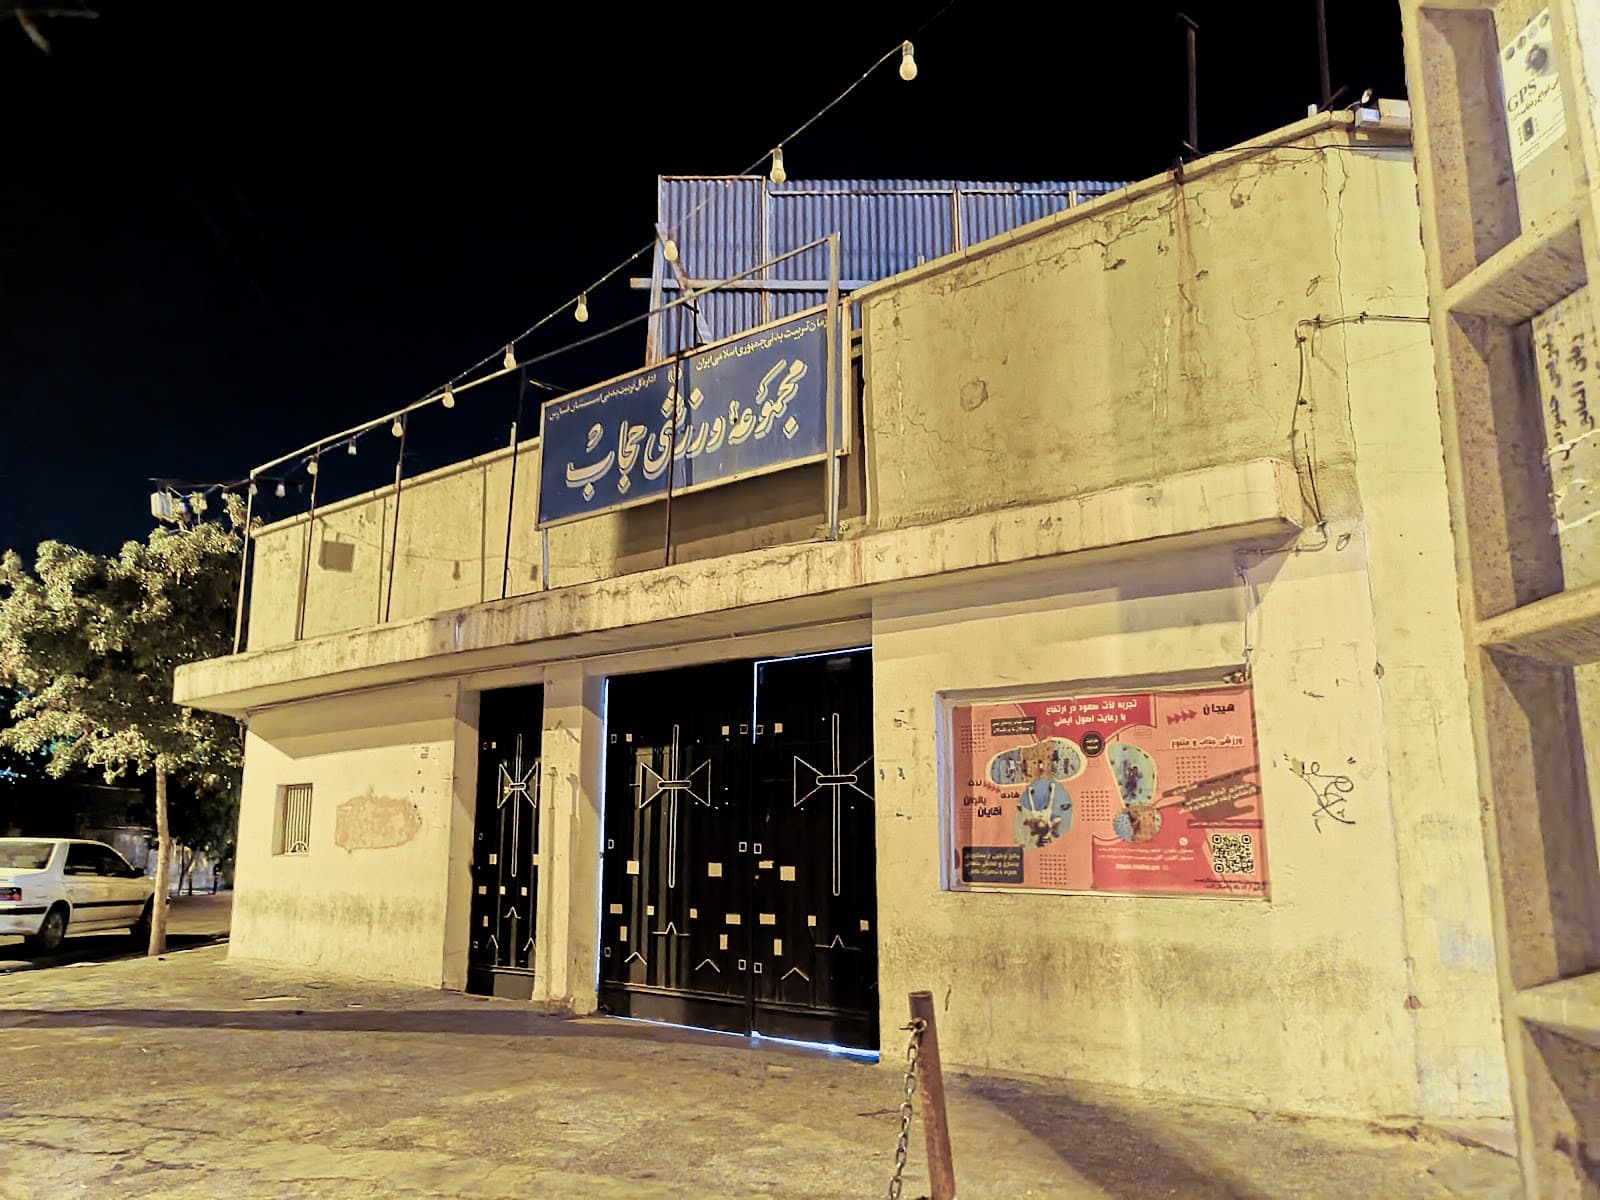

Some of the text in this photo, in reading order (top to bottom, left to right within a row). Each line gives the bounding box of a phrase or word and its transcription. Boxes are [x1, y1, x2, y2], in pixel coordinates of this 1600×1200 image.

[1507, 79, 1537, 112] GPS
[784, 320, 810, 341] تربیت
[736, 338, 766, 357] جمهوری
[765, 332, 784, 348] بدنی
[696, 355, 712, 371] ایران
[712, 345, 737, 367] اسلامی
[643, 384, 727, 480] ورزشی
[565, 420, 648, 502] حجاب
[1046, 699, 1138, 716] تجربه لذت صعود در ارتفاع
[1203, 703, 1235, 716] هیجان
[1054, 713, 1127, 727] با رعایت اصول ایمنی
[1170, 735, 1245, 749] ورزشی جذاب و متنوع
